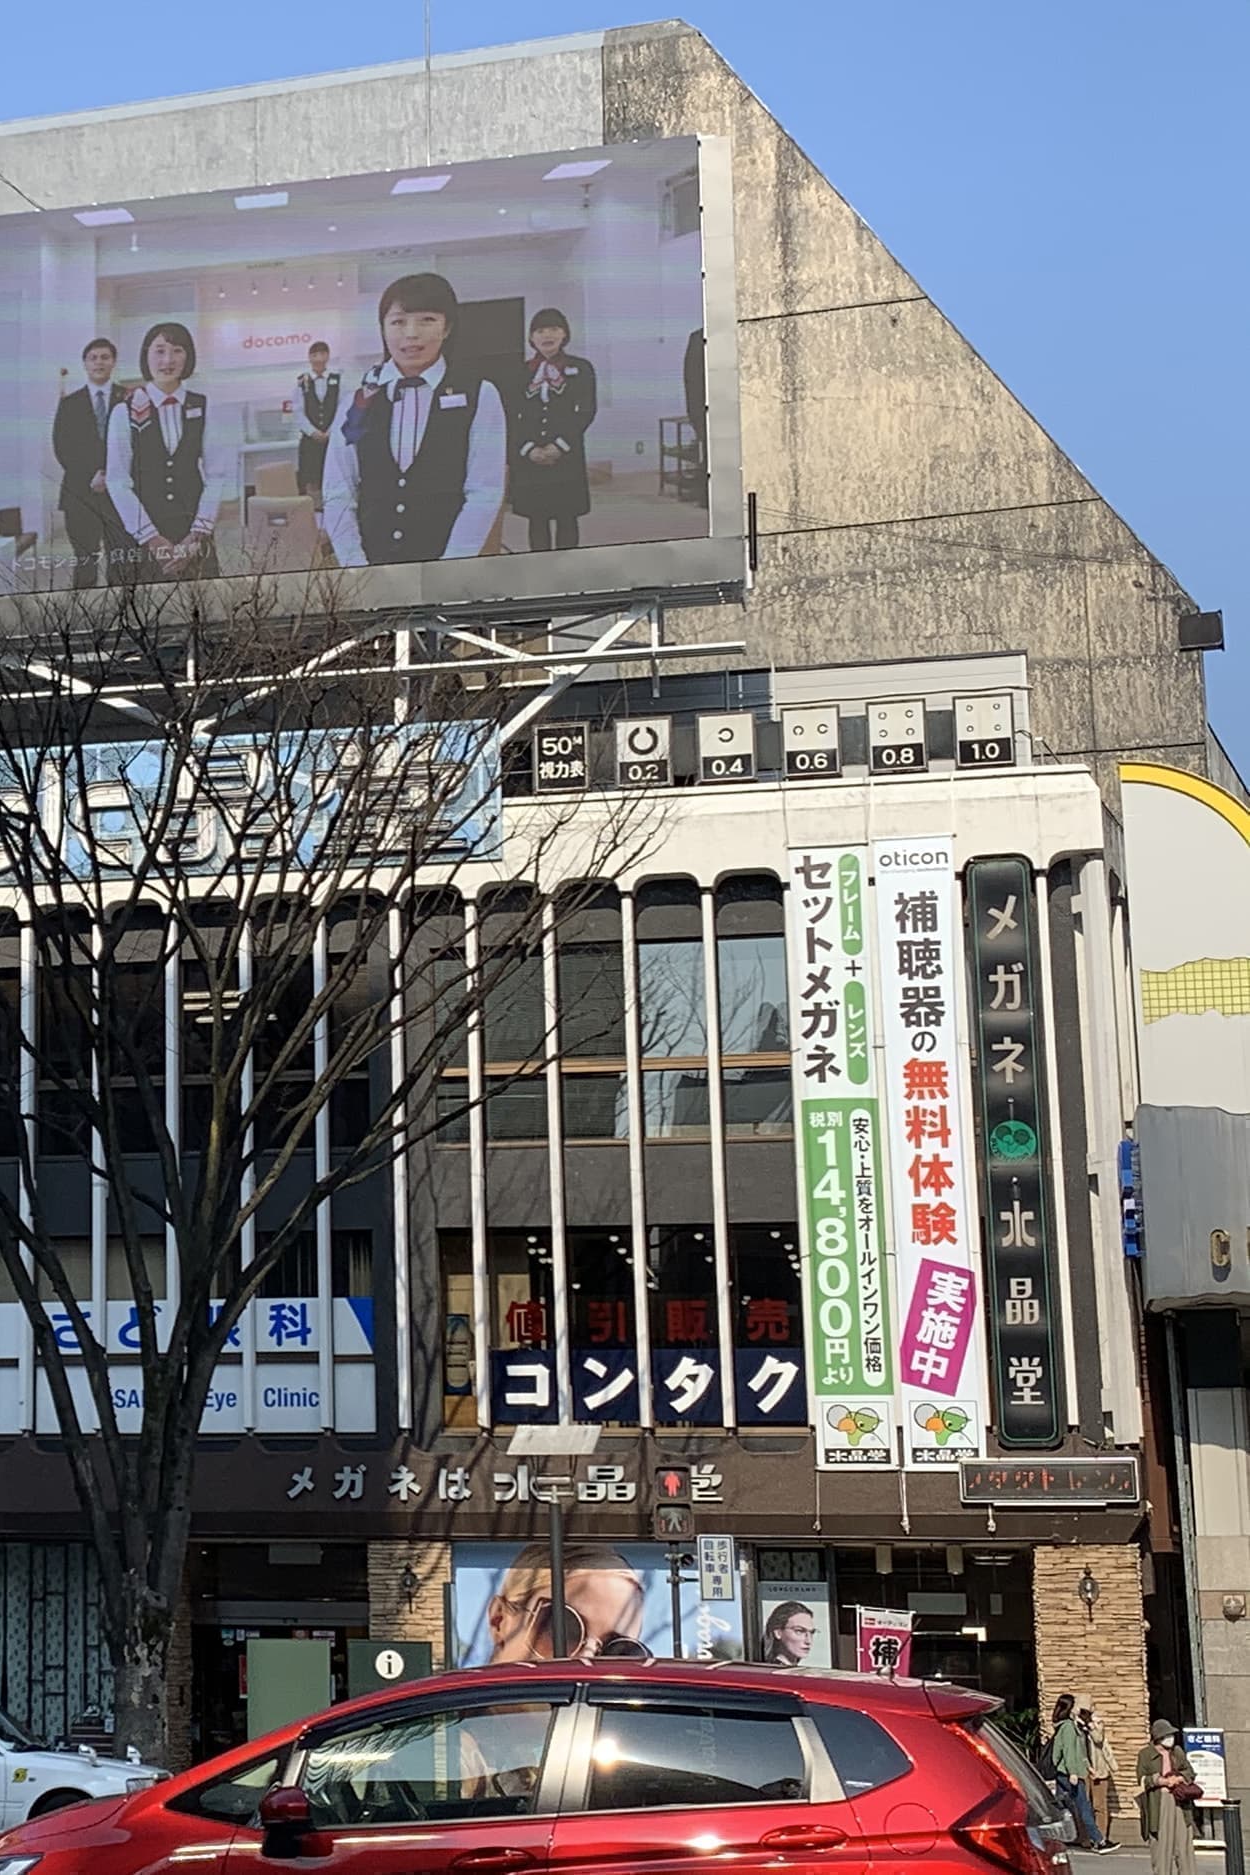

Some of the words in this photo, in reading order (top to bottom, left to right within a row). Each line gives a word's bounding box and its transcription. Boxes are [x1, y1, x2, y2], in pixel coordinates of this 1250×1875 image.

[243, 332, 312, 350] docomo
[795, 752, 829, 769] 0.6
[881, 747, 915, 765] 0.8
[971, 742, 1000, 760] 1.0
[539, 760, 585, 780] 視力表
[628, 763, 659, 781] 0.2
[711, 758, 744, 775] 0.4
[879, 848, 949, 867] oticon
[840, 870, 861, 941] フレーム
[795, 855, 842, 1084] セットメガネ
[986, 894, 1025, 1084] メガネ
[847, 1003, 867, 1058] レンズ
[894, 890, 958, 1247] 補聴器の無料体験
[809, 1111, 844, 1128] 税別
[852, 1116, 883, 1374] 安心・上質をオールインワン価格
[1000, 1199, 1045, 1406] 水晶堂
[506, 1298, 790, 1343] 値引販売
[909, 1270, 970, 1386] 実施中
[112, 1387, 146, 1409] SA
[204, 1388, 237, 1412] Eye
[263, 1386, 320, 1409] Clinic
[703, 1540, 715, 1573] 自転車
[717, 1540, 729, 1574] 歩行者
[712, 1575, 723, 1598] 専用
